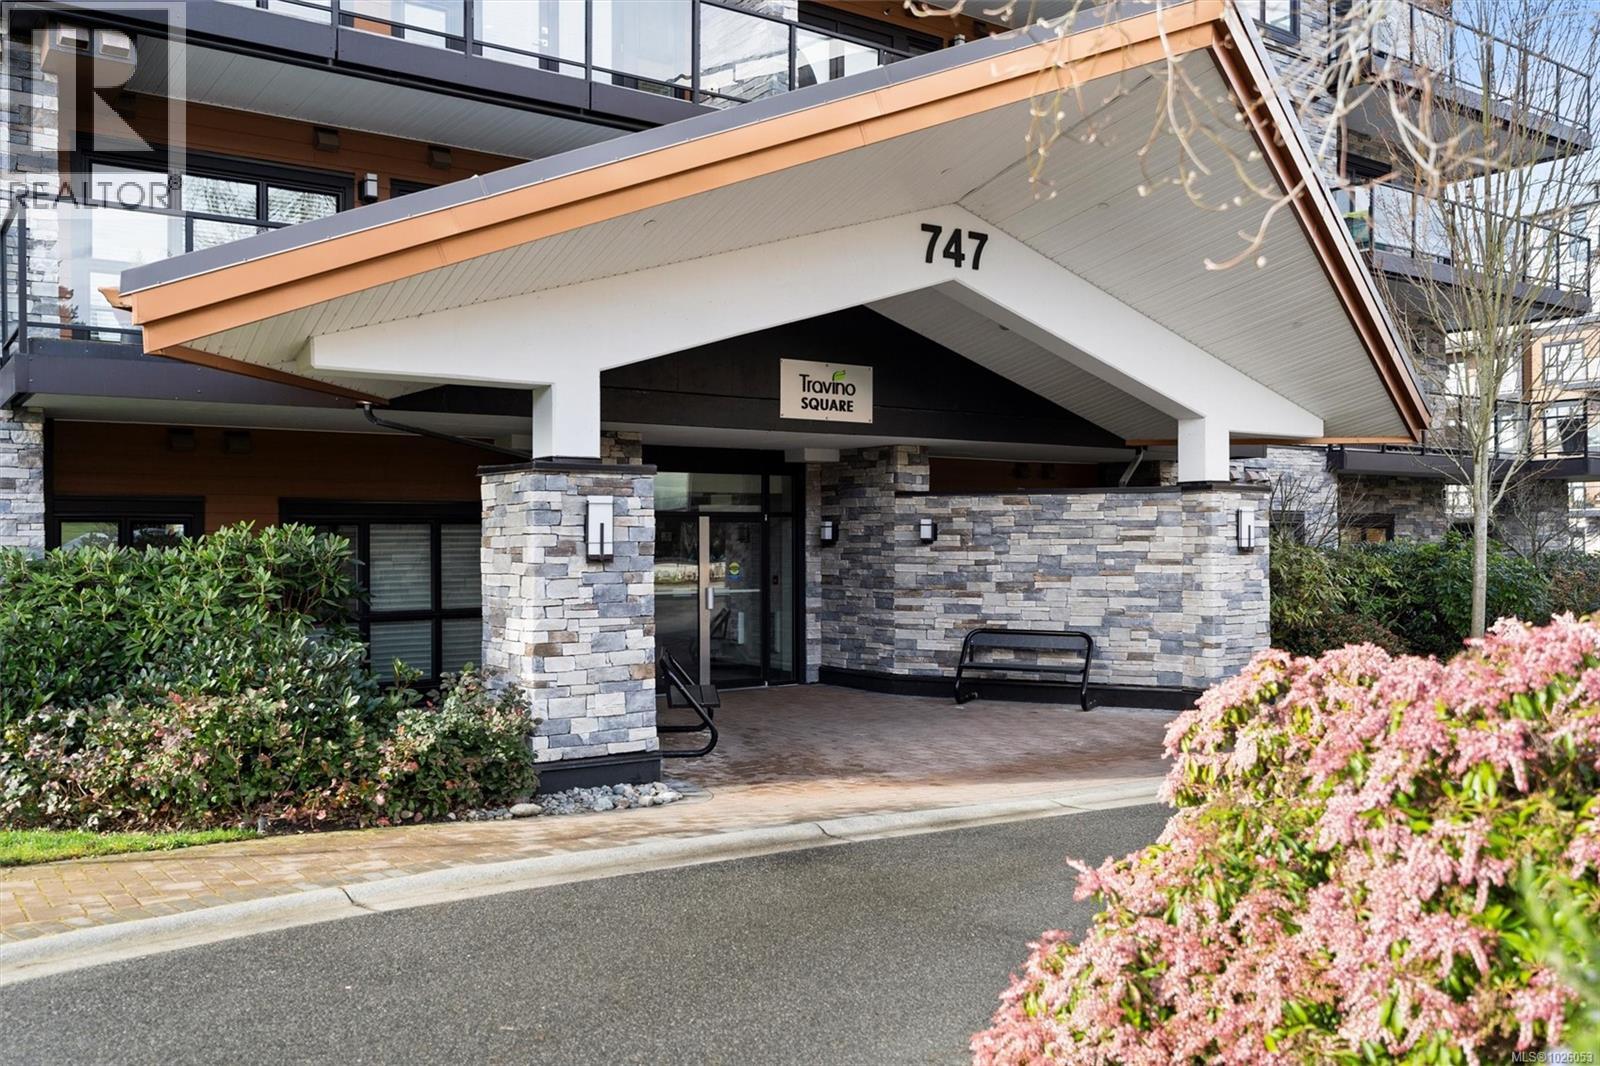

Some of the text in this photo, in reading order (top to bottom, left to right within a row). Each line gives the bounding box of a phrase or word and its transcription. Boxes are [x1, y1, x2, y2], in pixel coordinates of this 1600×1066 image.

[921, 223, 988, 270] 747
[799, 373, 856, 396] Travino
[801, 397, 854, 412] SQUARE
